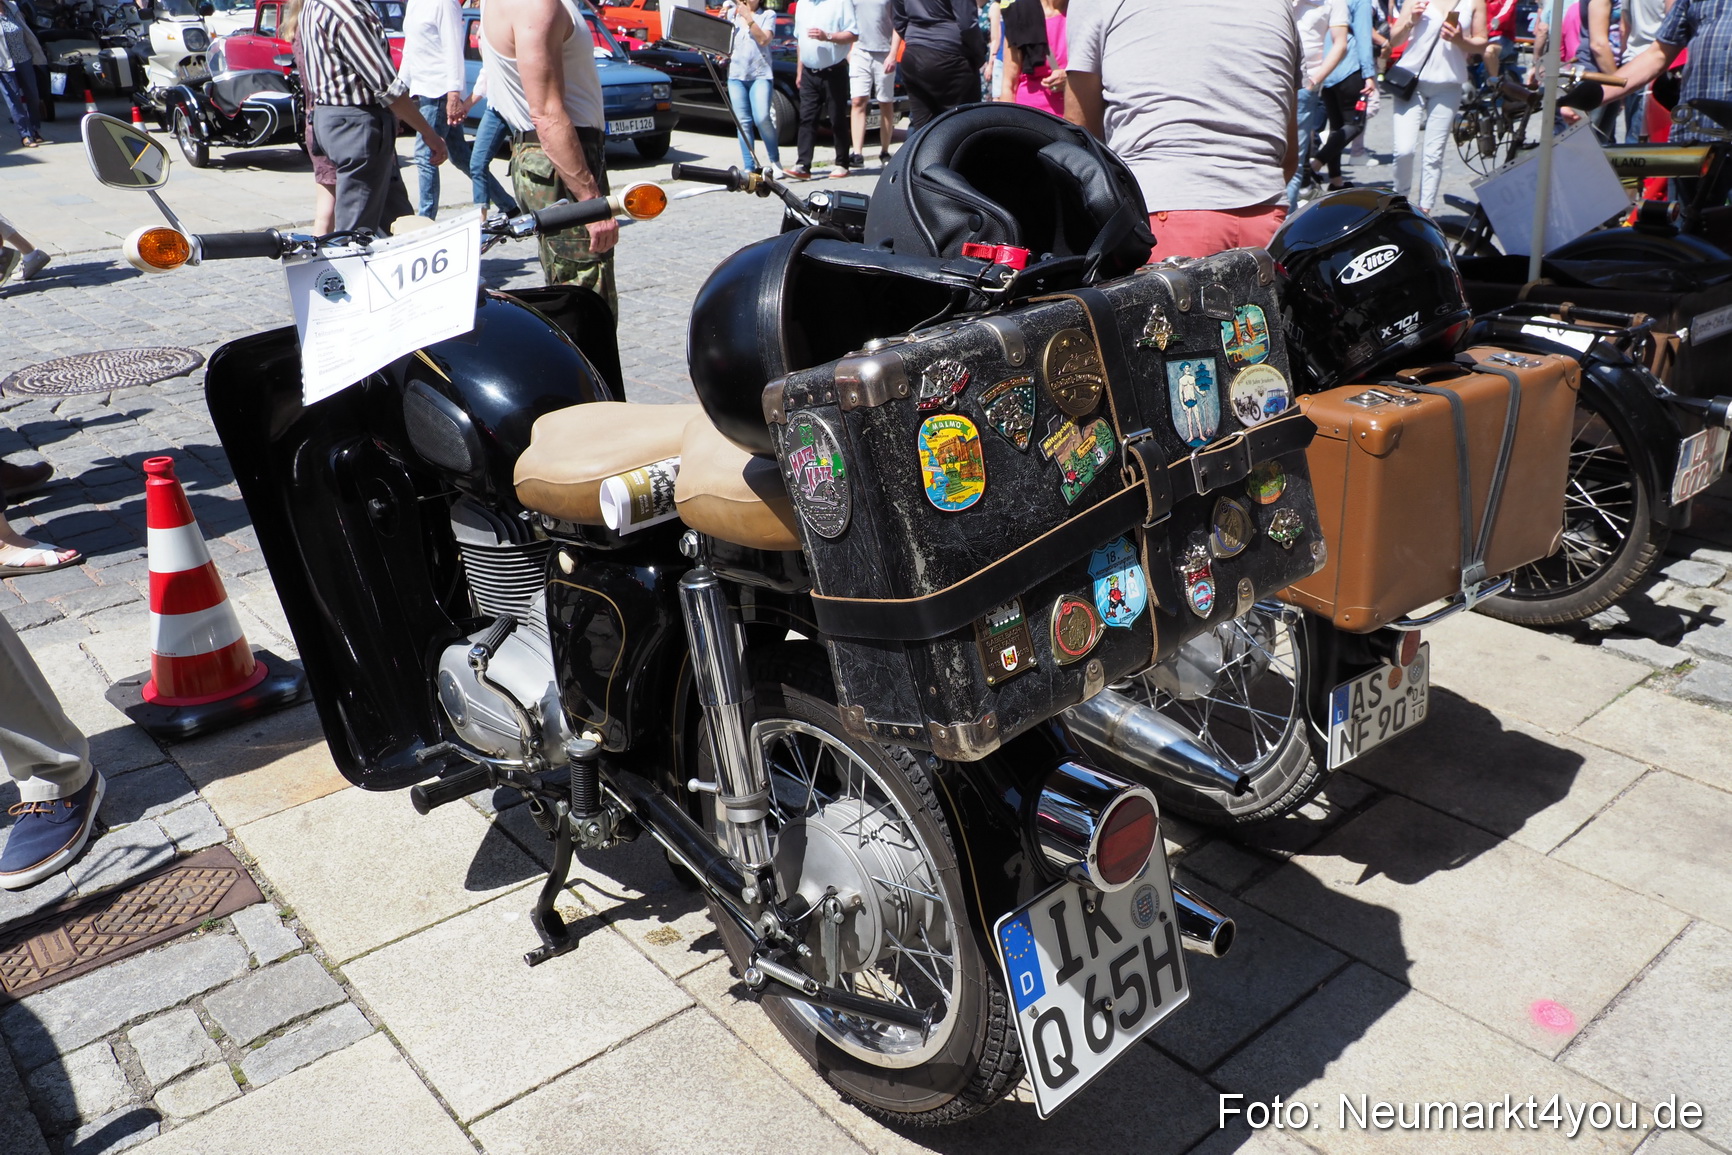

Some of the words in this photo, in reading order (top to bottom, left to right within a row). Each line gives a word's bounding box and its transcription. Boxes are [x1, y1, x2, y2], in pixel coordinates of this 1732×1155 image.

[610, 121, 625, 133] LAU
[640, 118, 654, 130] 126
[391, 248, 449, 290] 106
[1343, 248, 1396, 282] X-lite
[1351, 672, 1383, 719] AS
[1339, 713, 1372, 762] NF
[1379, 696, 1407, 741] 90
[1020, 970, 1035, 996] D
[1049, 886, 1123, 986] IK
[1032, 1006, 1080, 1090] Q
[1083, 921, 1183, 1055] 65H
